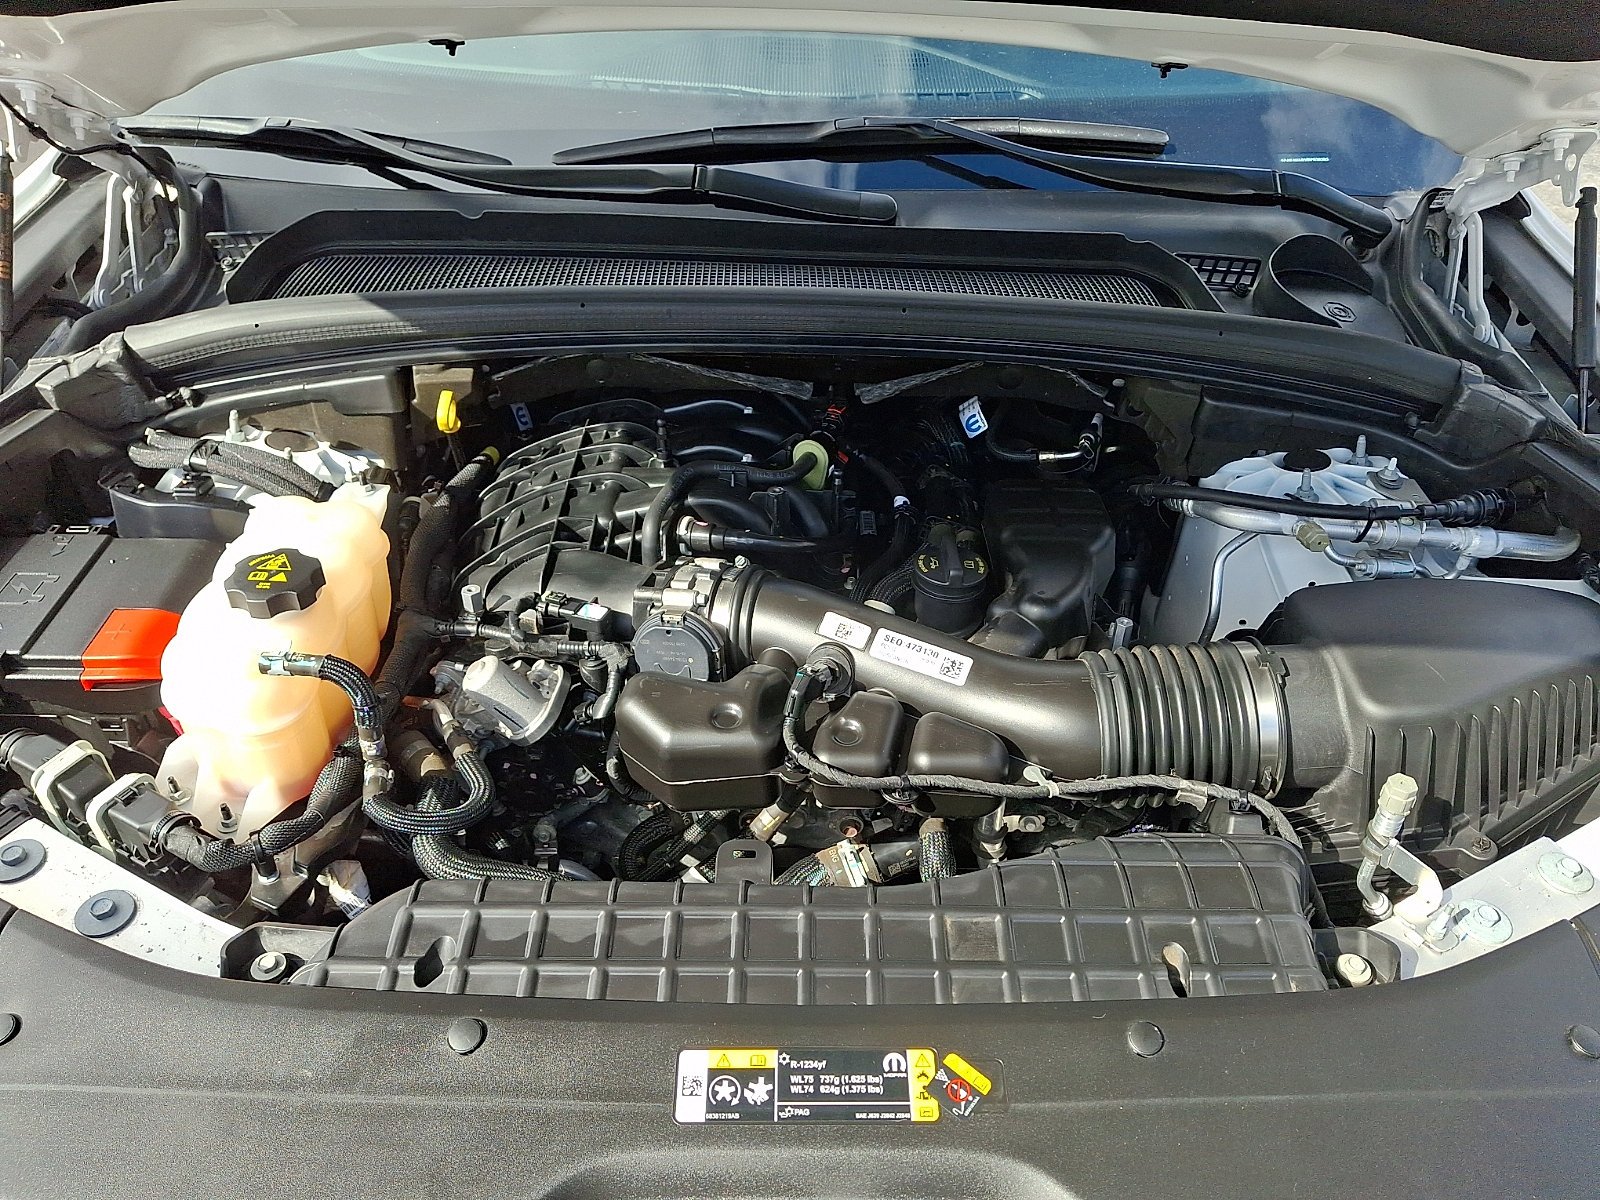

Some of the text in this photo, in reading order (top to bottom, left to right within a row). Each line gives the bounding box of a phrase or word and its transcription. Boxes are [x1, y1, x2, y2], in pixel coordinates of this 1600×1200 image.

[790, 1060, 827, 1071] R-1234yf
[789, 1074, 815, 1084] WL75
[819, 1074, 840, 1085] 737g
[789, 1085, 815, 1094] WL74
[841, 1085, 867, 1095] (1.375
[794, 1108, 810, 1116] PAG
